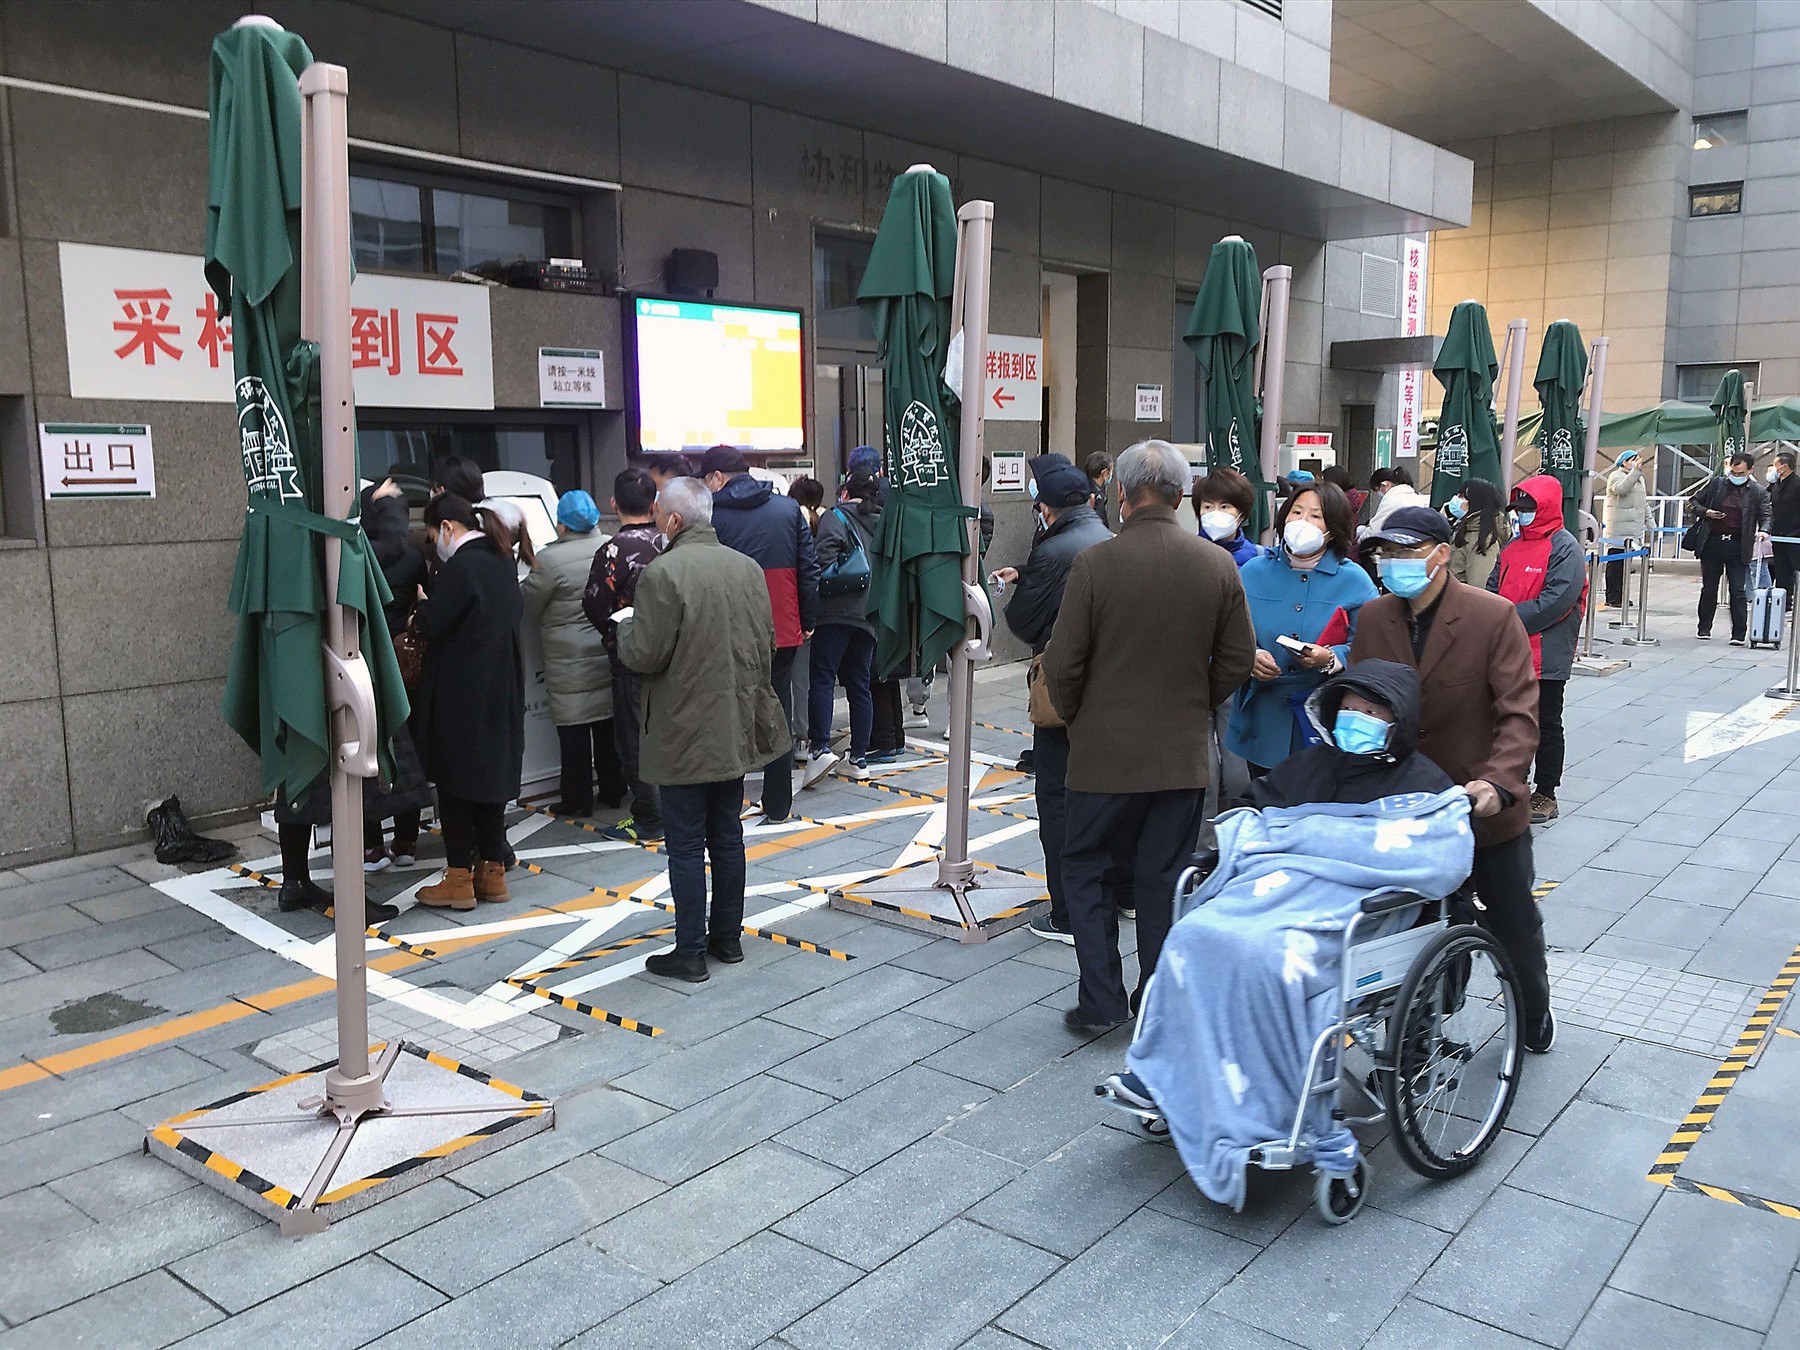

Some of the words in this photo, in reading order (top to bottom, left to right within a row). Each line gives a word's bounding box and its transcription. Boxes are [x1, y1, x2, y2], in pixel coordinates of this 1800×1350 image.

[547, 365, 596, 378] 请按一米线
[553, 381, 592, 393] 站立等候
[64, 440, 135, 472] 出口
[998, 462, 1019, 476] 出口
